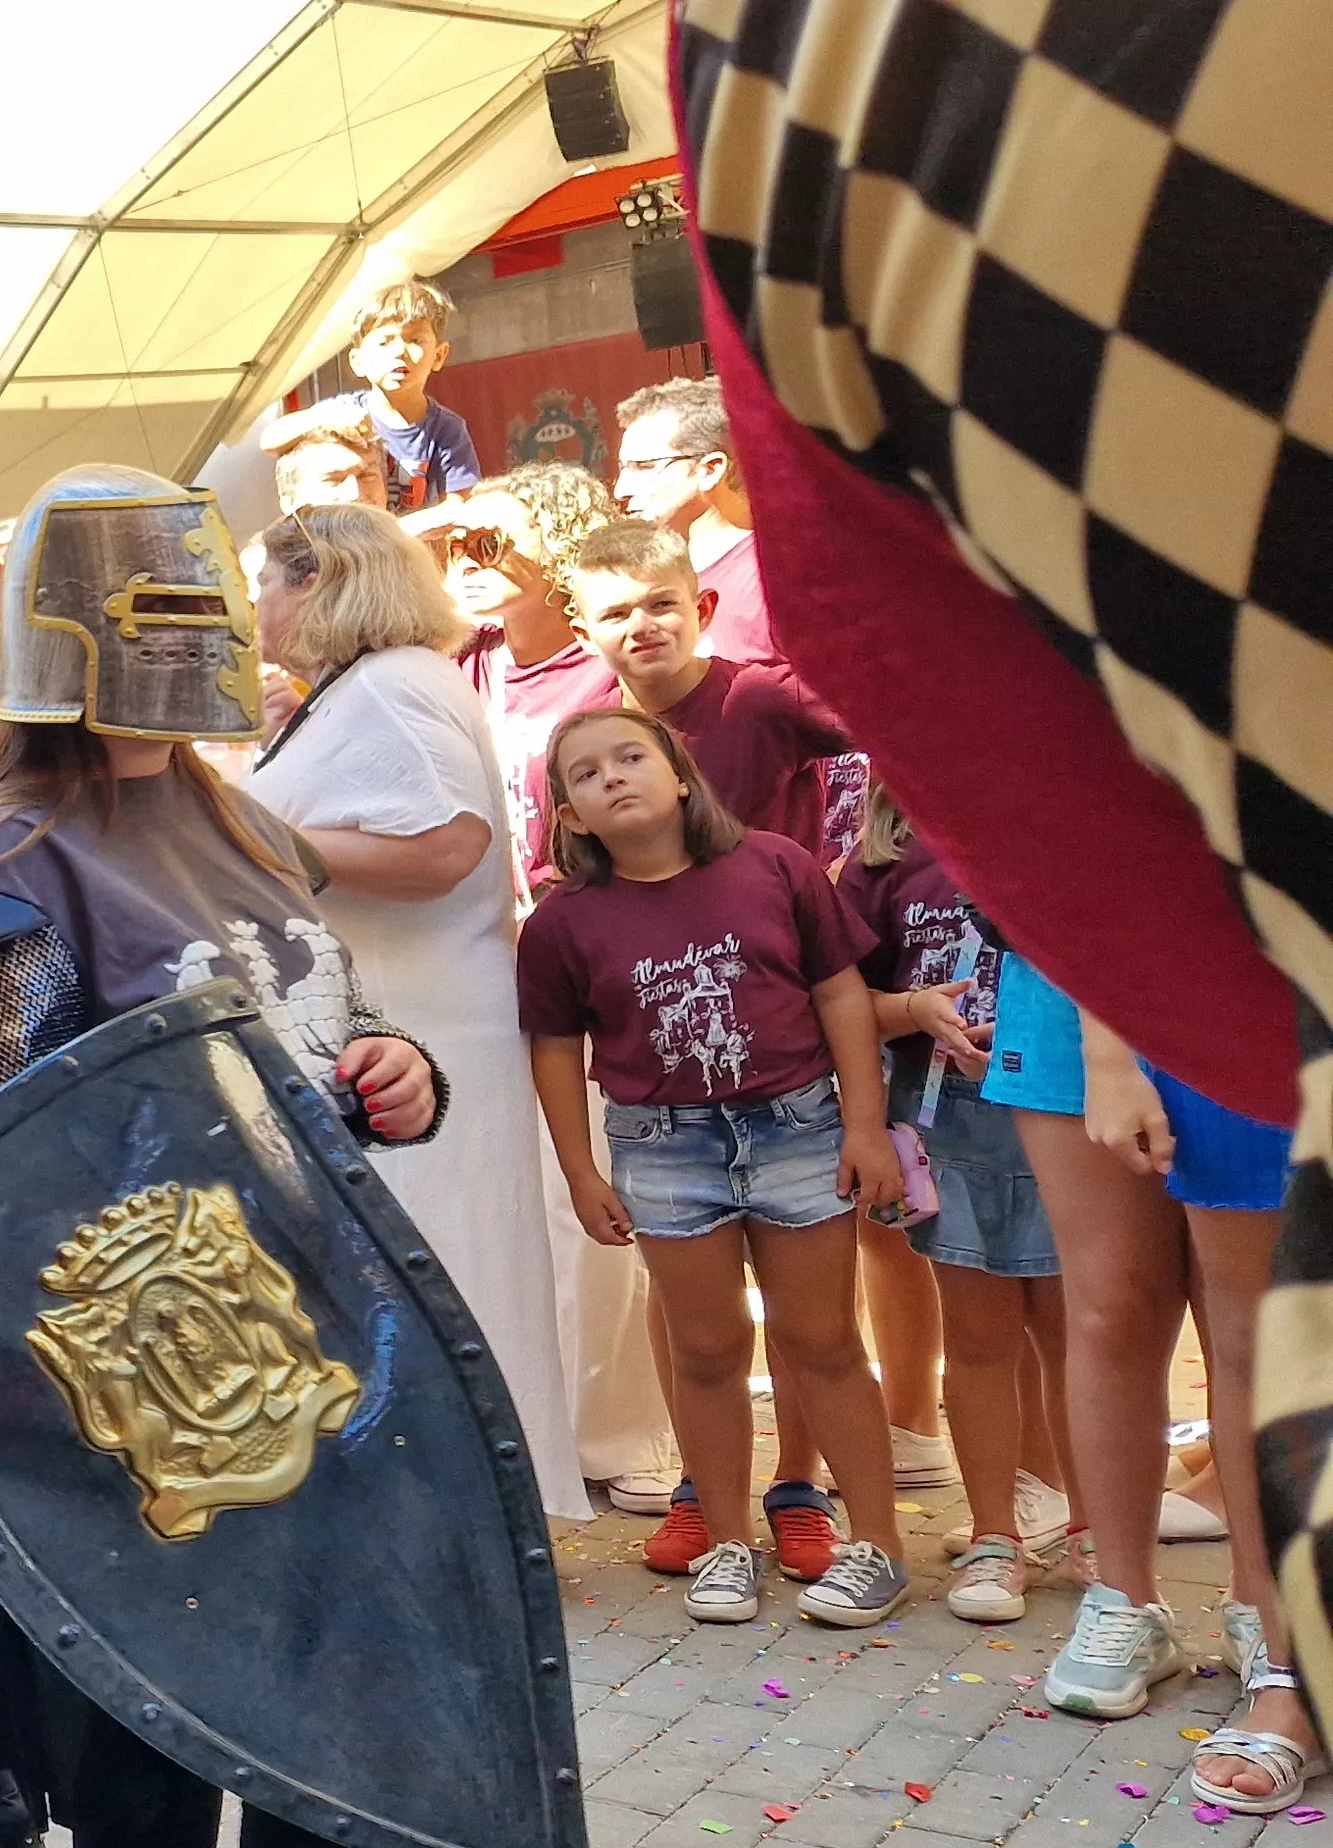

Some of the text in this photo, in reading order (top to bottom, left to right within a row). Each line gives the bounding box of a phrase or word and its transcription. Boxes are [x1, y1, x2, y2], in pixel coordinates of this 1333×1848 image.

[902, 924, 945, 949] Fiestas
[629, 932, 742, 985] Almudévar
[635, 978, 683, 1010] Fiestas
